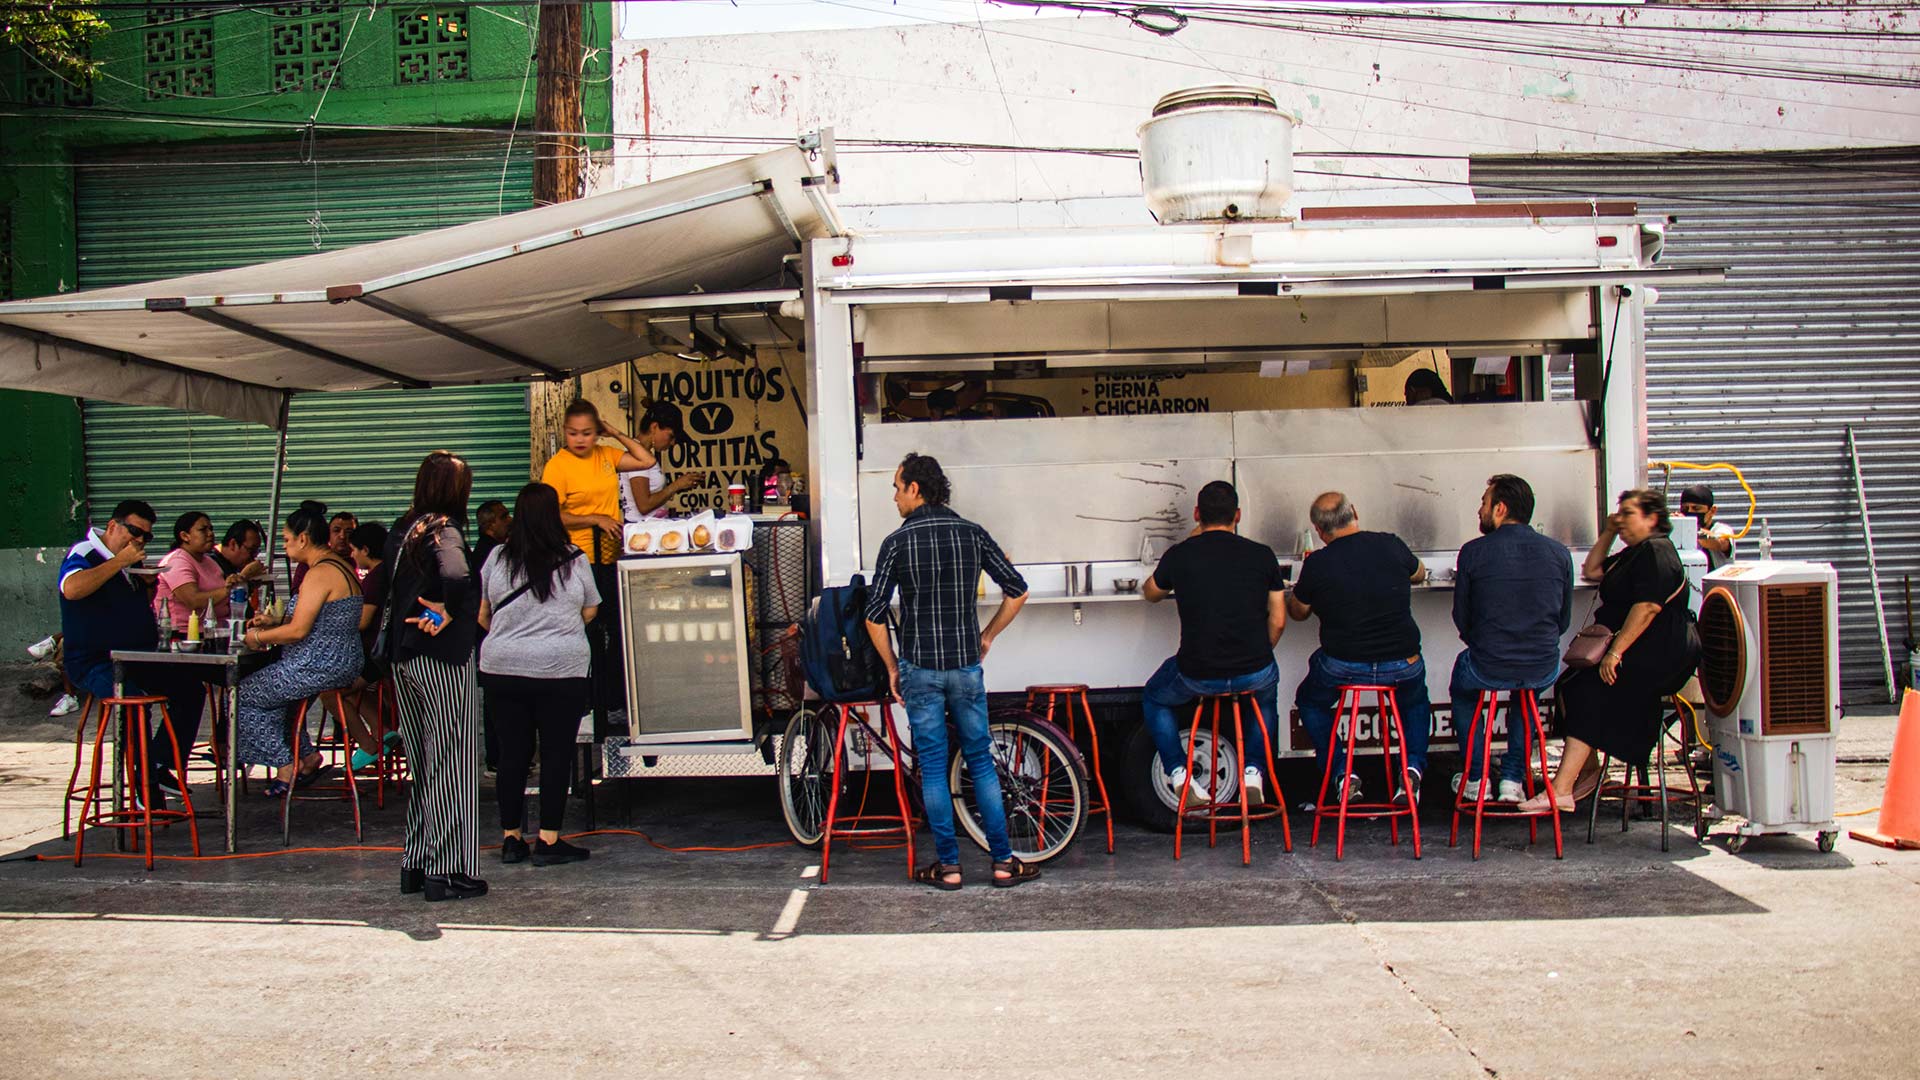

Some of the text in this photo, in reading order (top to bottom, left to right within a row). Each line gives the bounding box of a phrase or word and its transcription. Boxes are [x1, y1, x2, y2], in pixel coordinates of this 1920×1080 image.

[639, 367, 785, 406] TAQUITOS
[1095, 382, 1160, 399] PIERNA
[1095, 397, 1210, 416] CHICHARRON
[702, 406, 722, 431] Y
[680, 493, 709, 508] CON
